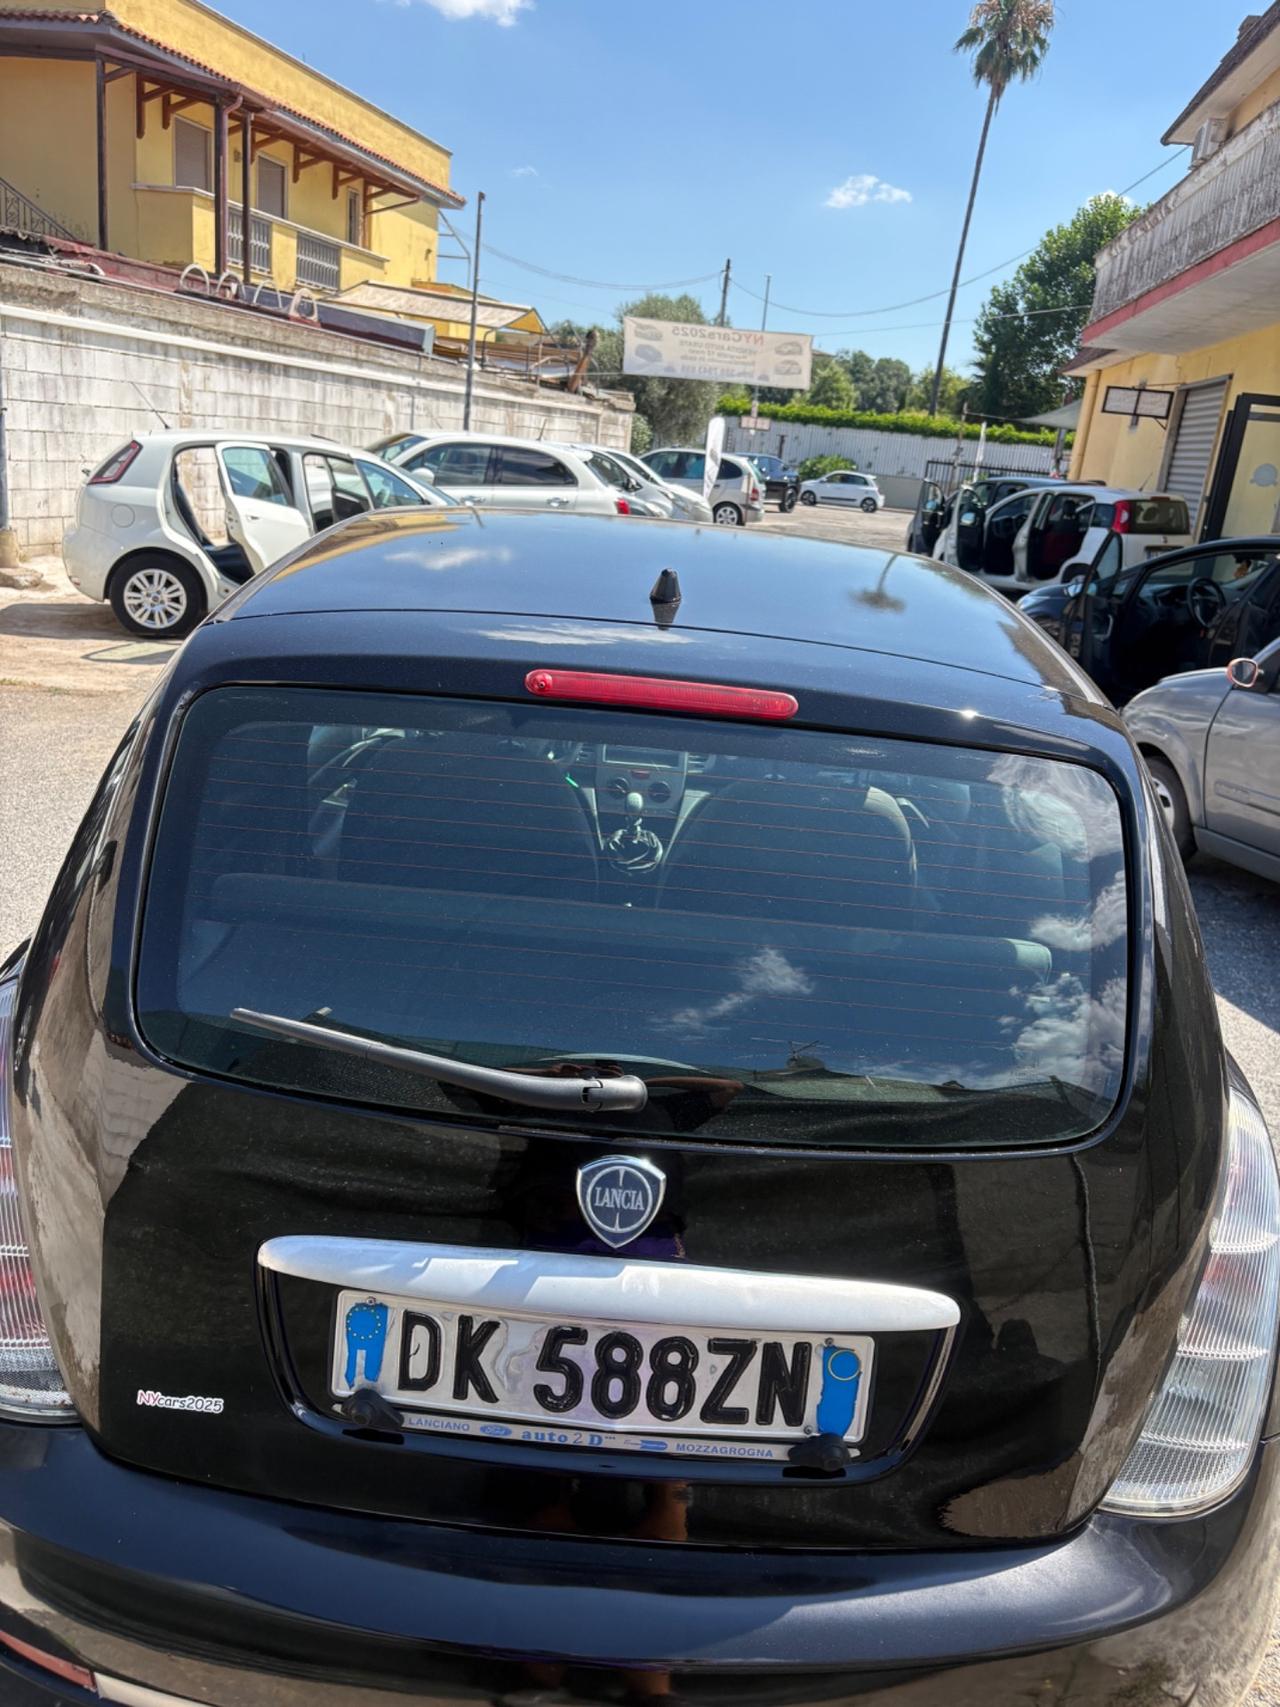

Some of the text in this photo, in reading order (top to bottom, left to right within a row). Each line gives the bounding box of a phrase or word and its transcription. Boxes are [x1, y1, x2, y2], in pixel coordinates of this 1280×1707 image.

[594, 1186, 645, 1211] LANCIA
[398, 1309, 812, 1427] DK 588ZN
[137, 1390, 224, 1413] NYcars2025
[409, 1418, 470, 1432] LANCIANO
[522, 1431, 568, 1443] auto
[573, 1432, 582, 1444] 2
[676, 1443, 773, 1458] MOZZAGROGNA
